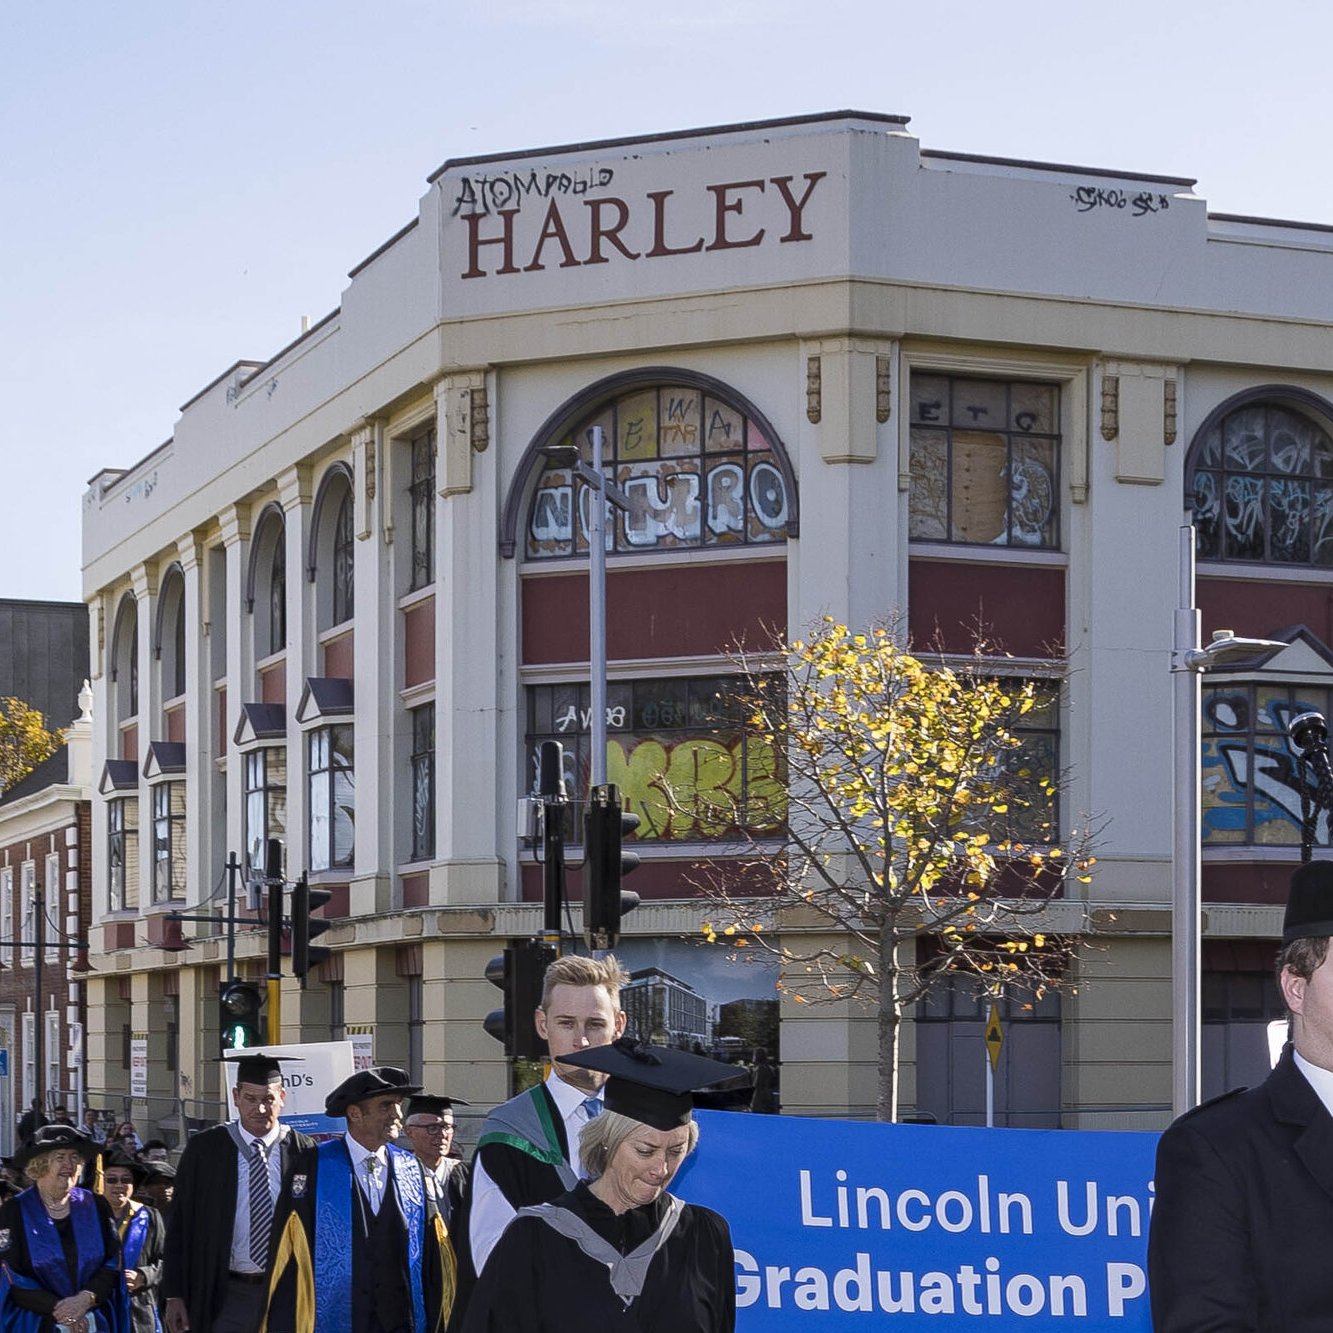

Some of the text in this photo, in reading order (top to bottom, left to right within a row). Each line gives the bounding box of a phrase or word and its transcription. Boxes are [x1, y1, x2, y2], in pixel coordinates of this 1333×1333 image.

[460, 170, 829, 280] HARLEY
[281, 1073, 314, 1088] hD's
[800, 1169, 1033, 1235] Lincoln
[735, 1250, 1088, 1317] Graduation
